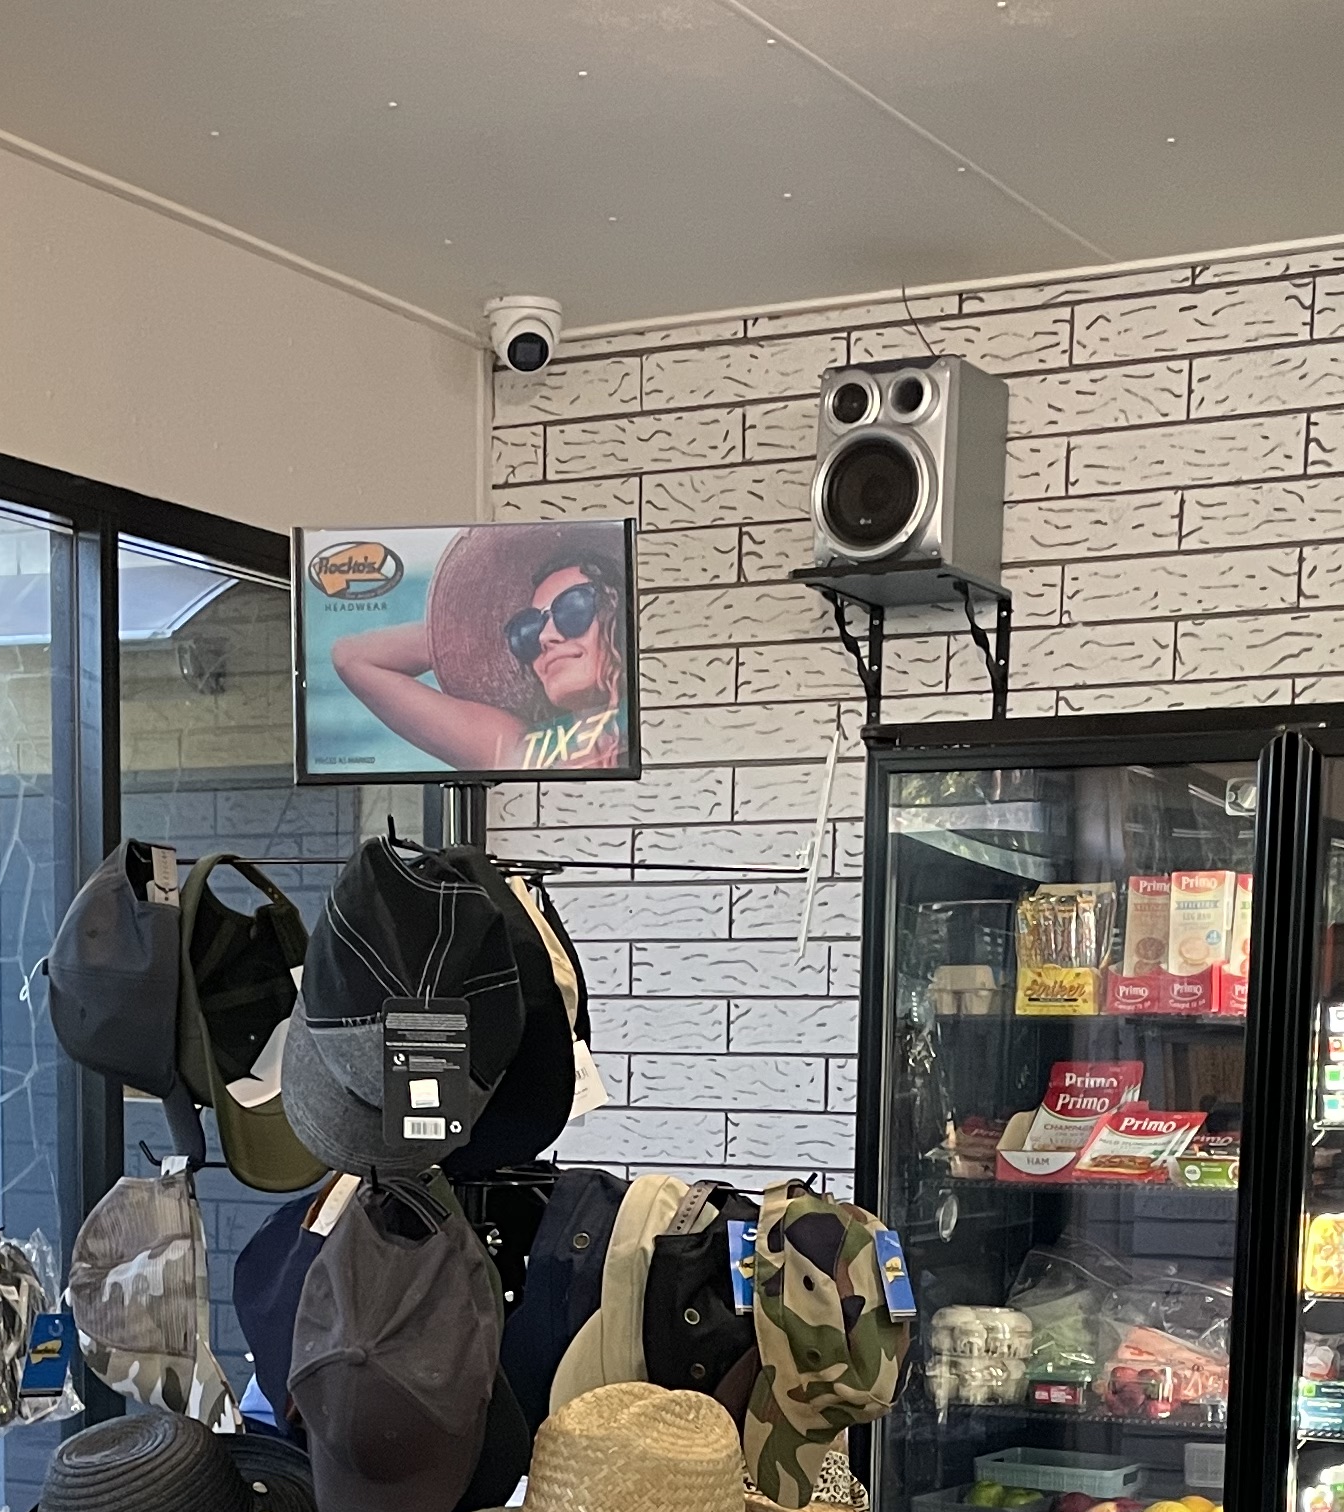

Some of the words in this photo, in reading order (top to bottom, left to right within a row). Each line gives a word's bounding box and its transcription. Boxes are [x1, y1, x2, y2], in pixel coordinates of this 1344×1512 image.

[324, 601, 388, 612] HEADWEAR
[1182, 876, 1218, 890] Primo
[1056, 1093, 1110, 1113] Primo
[1119, 1117, 1177, 1133] Primo
